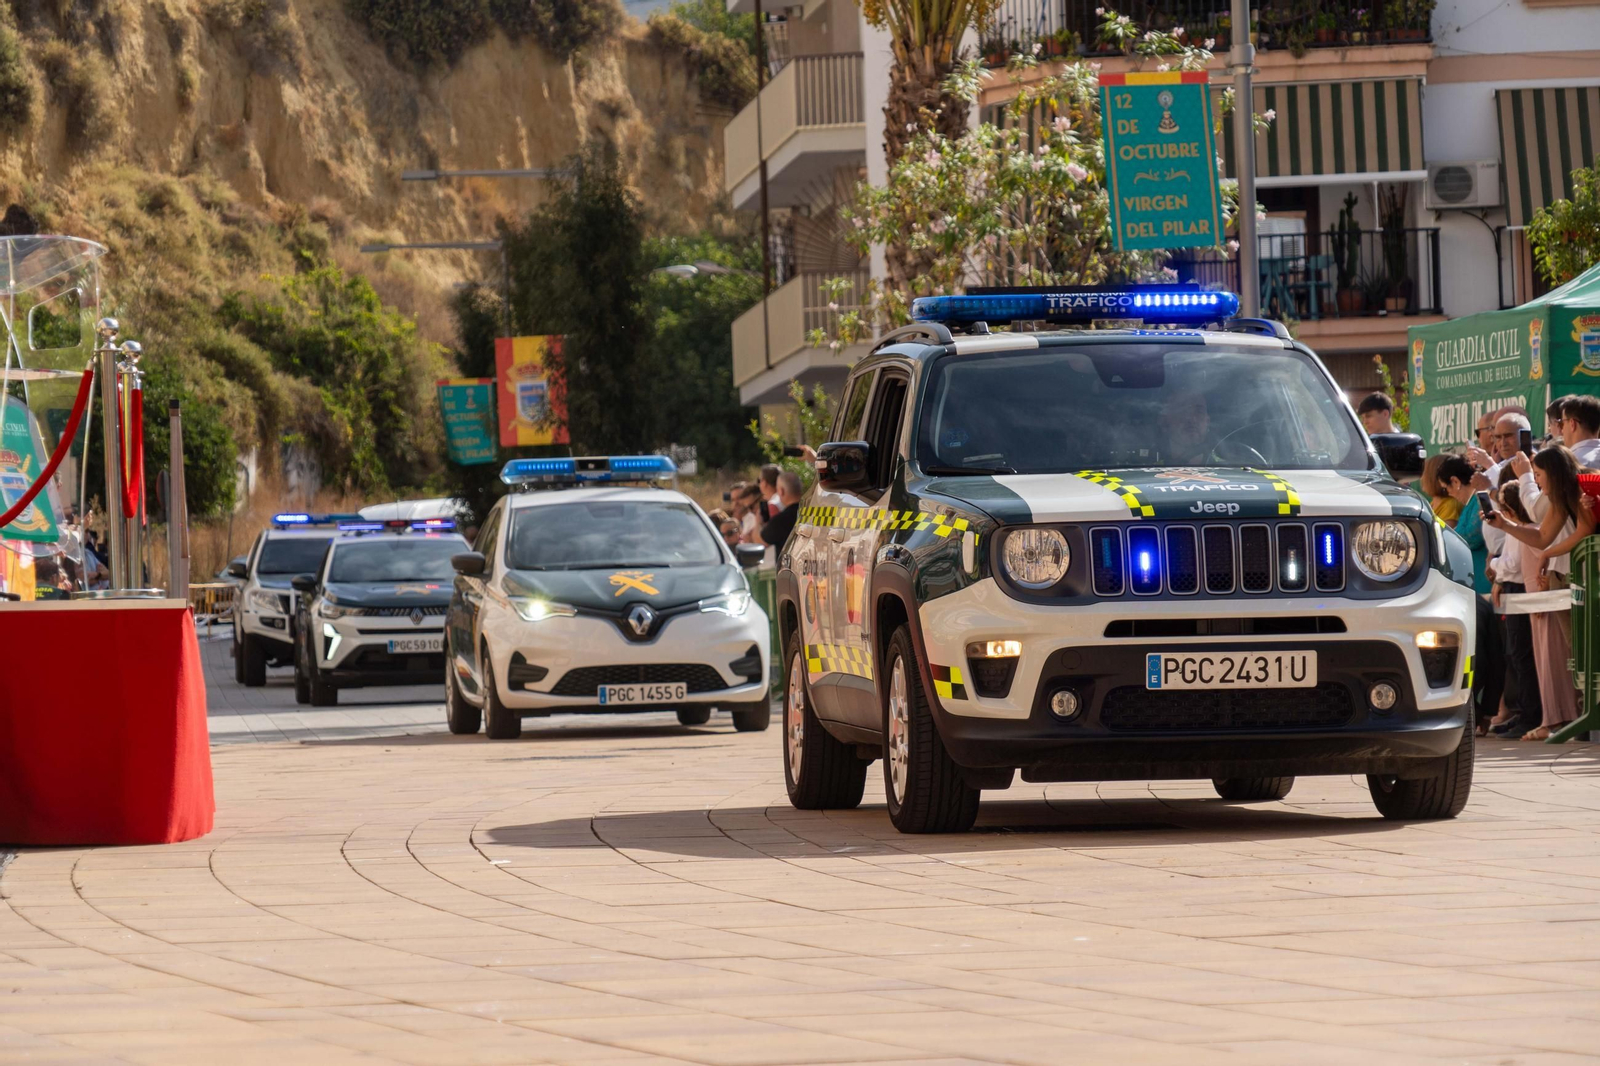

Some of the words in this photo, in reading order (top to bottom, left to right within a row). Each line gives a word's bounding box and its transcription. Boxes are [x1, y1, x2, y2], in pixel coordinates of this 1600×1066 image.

[1114, 93, 1133, 109] 12
[1117, 119, 1139, 135] DE
[1119, 142, 1200, 161] OCTUBRE
[1123, 194, 1188, 212] VIRGEN
[1126, 222, 1158, 239] DEL
[1163, 219, 1210, 236] PILAR
[1046, 297, 1133, 308] TRAFICO
[1436, 333, 1487, 369] GUARDIA
[1489, 328, 1521, 359] CIVIL
[1436, 370, 1483, 390] COMANDANCIA
[1484, 368, 1494, 383] DE
[1495, 364, 1522, 381] HUELVA
[5, 422, 27, 432] CIVIL
[1430, 402, 1469, 446] PUESTO
[1189, 500, 1241, 516] Jeep
